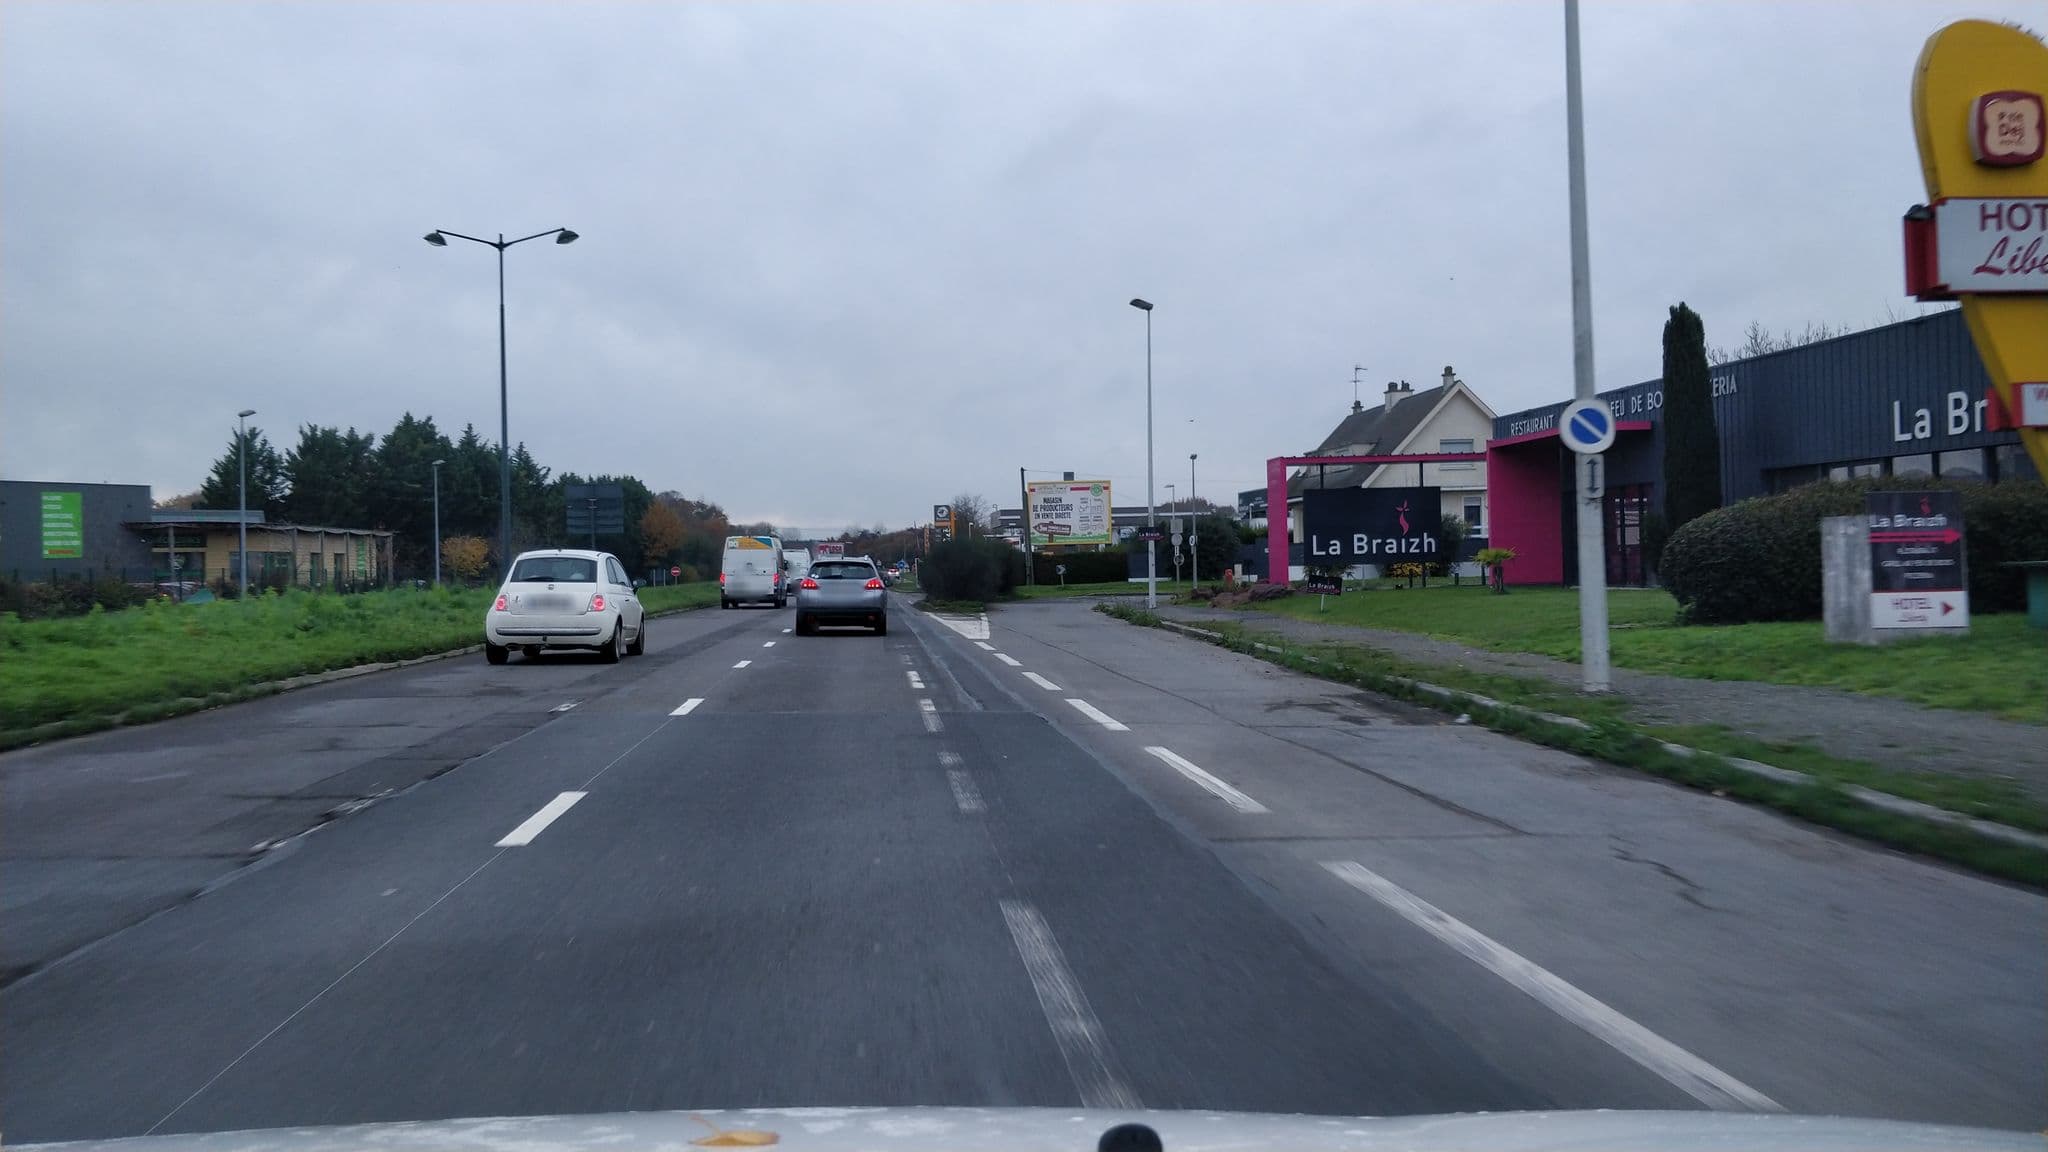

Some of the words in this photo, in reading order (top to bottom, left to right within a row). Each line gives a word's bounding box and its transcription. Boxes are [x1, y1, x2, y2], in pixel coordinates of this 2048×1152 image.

[1979, 203, 2048, 232] HOT
[1510, 414, 1554, 437] RESTAURANT
[1631, 396, 1643, 413] DE
[1710, 374, 1738, 398] ERIA
[1893, 400, 1932, 442] La
[1947, 391, 1989, 436] Br
[1312, 534, 1341, 556] La
[1353, 532, 1436, 555] Braizh
